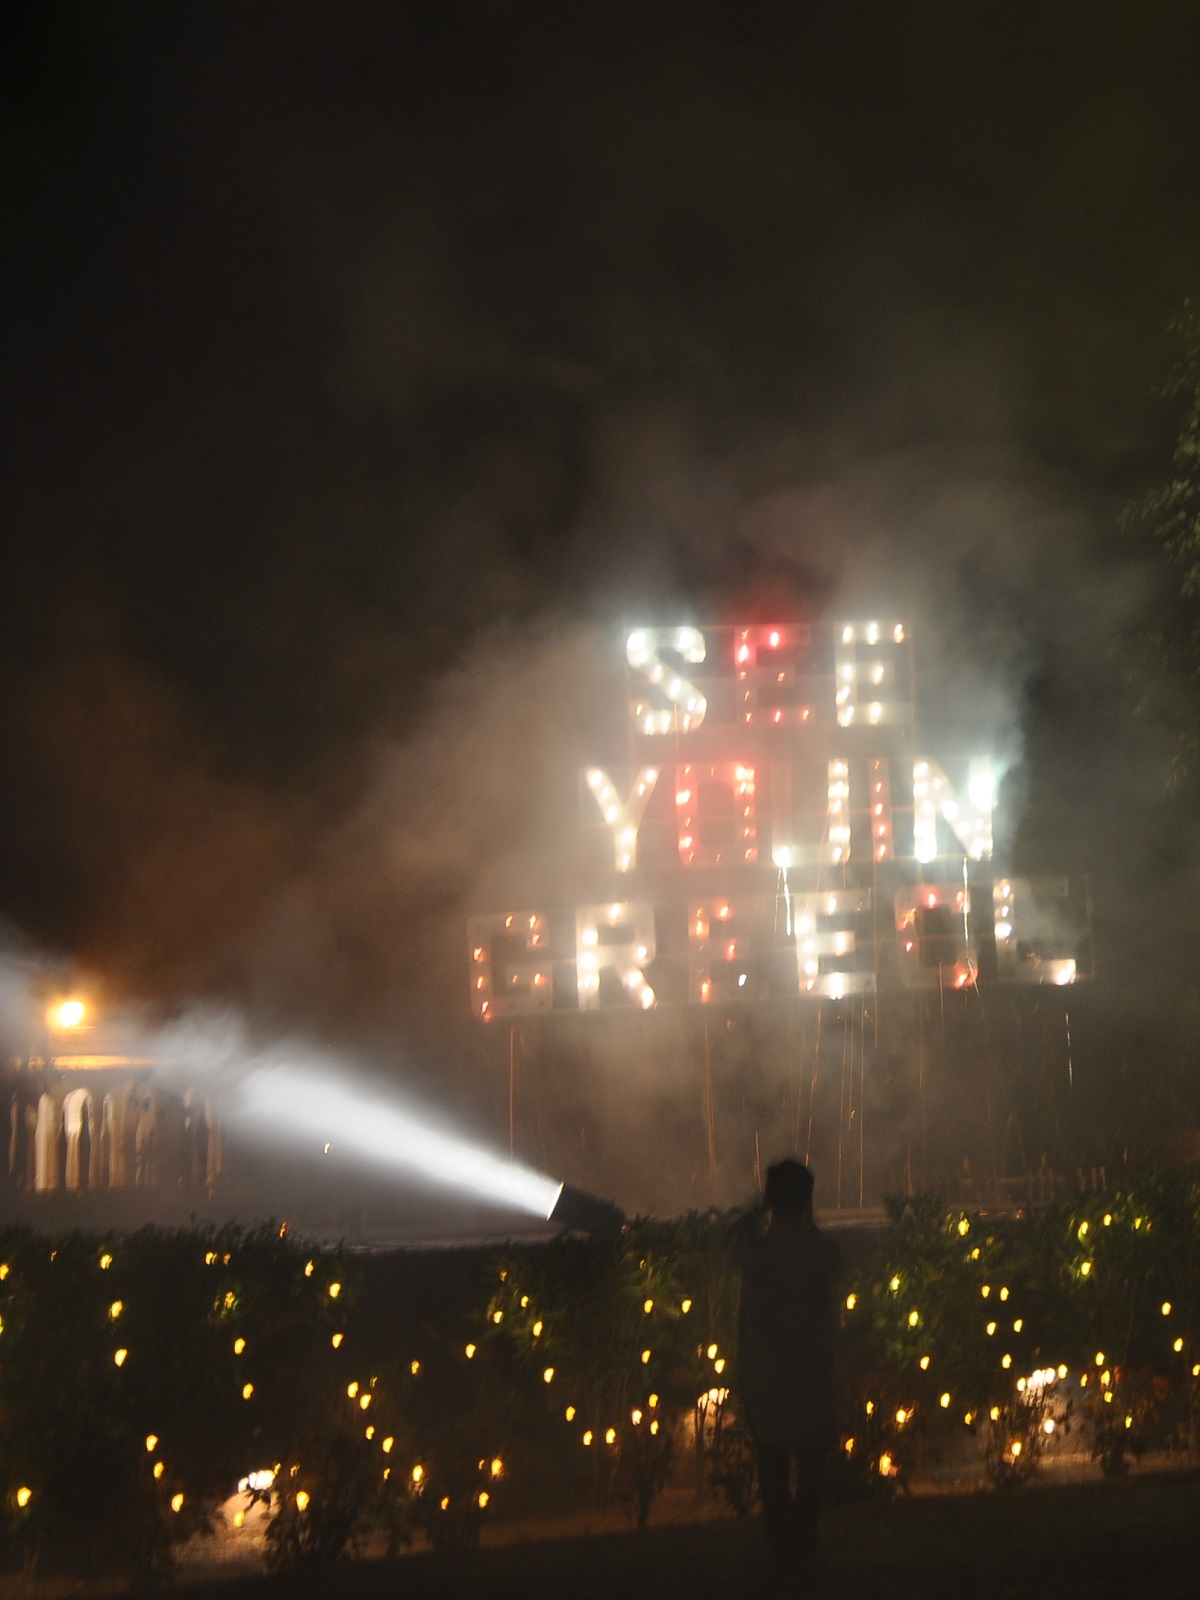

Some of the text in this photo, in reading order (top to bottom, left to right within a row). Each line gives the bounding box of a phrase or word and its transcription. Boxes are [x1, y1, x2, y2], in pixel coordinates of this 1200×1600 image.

[625, 621, 909, 736] SEE
[584, 755, 996, 872] YOU IN
